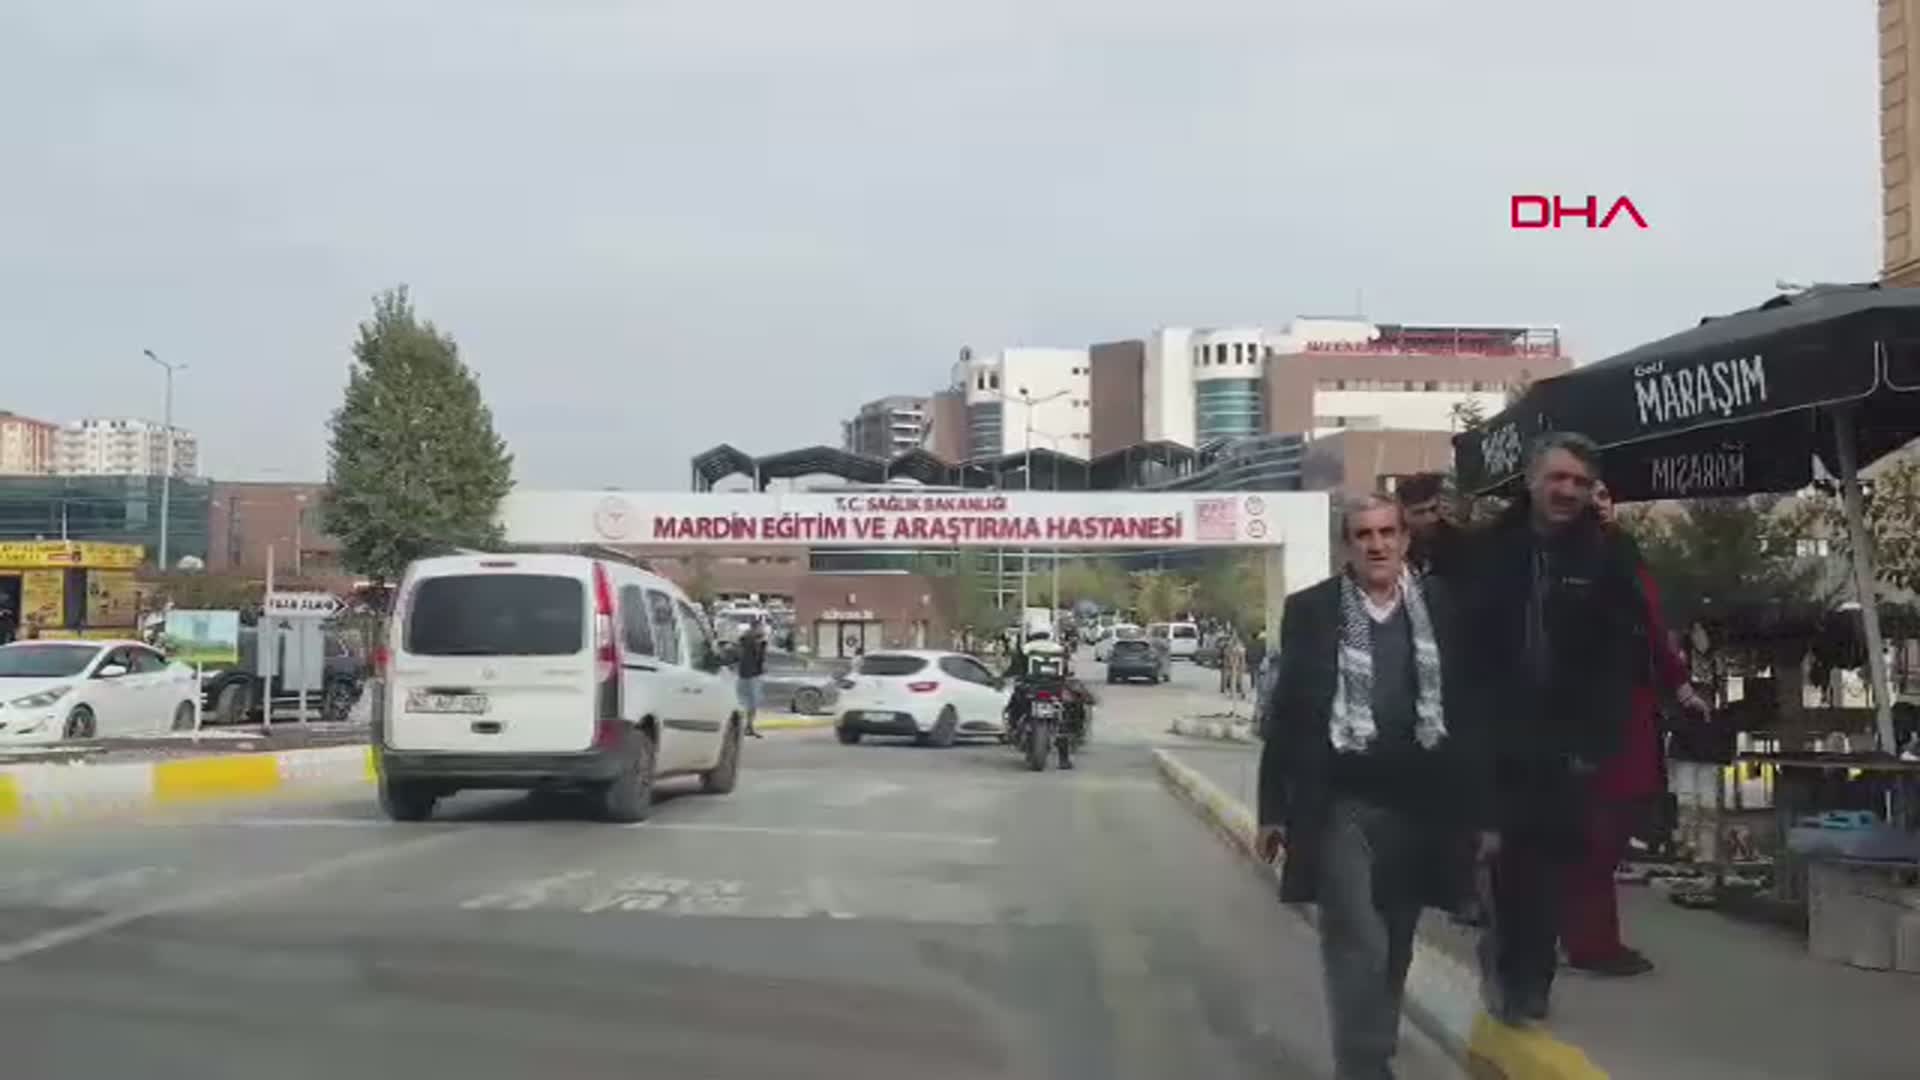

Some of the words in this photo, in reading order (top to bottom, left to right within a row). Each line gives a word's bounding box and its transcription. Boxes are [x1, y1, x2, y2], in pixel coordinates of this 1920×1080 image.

[1634, 354, 1768, 425] MARAŞIM
[866, 495, 921, 512] SAĞLIK
[923, 496, 1007, 512] BAKANLIĞI
[653, 512, 757, 540] MARDİN
[761, 511, 846, 540] EĞİTİM
[853, 516, 885, 539] VE
[893, 515, 1042, 545] ARAŞTIRMA
[1047, 510, 1184, 540] HASTANESİ
